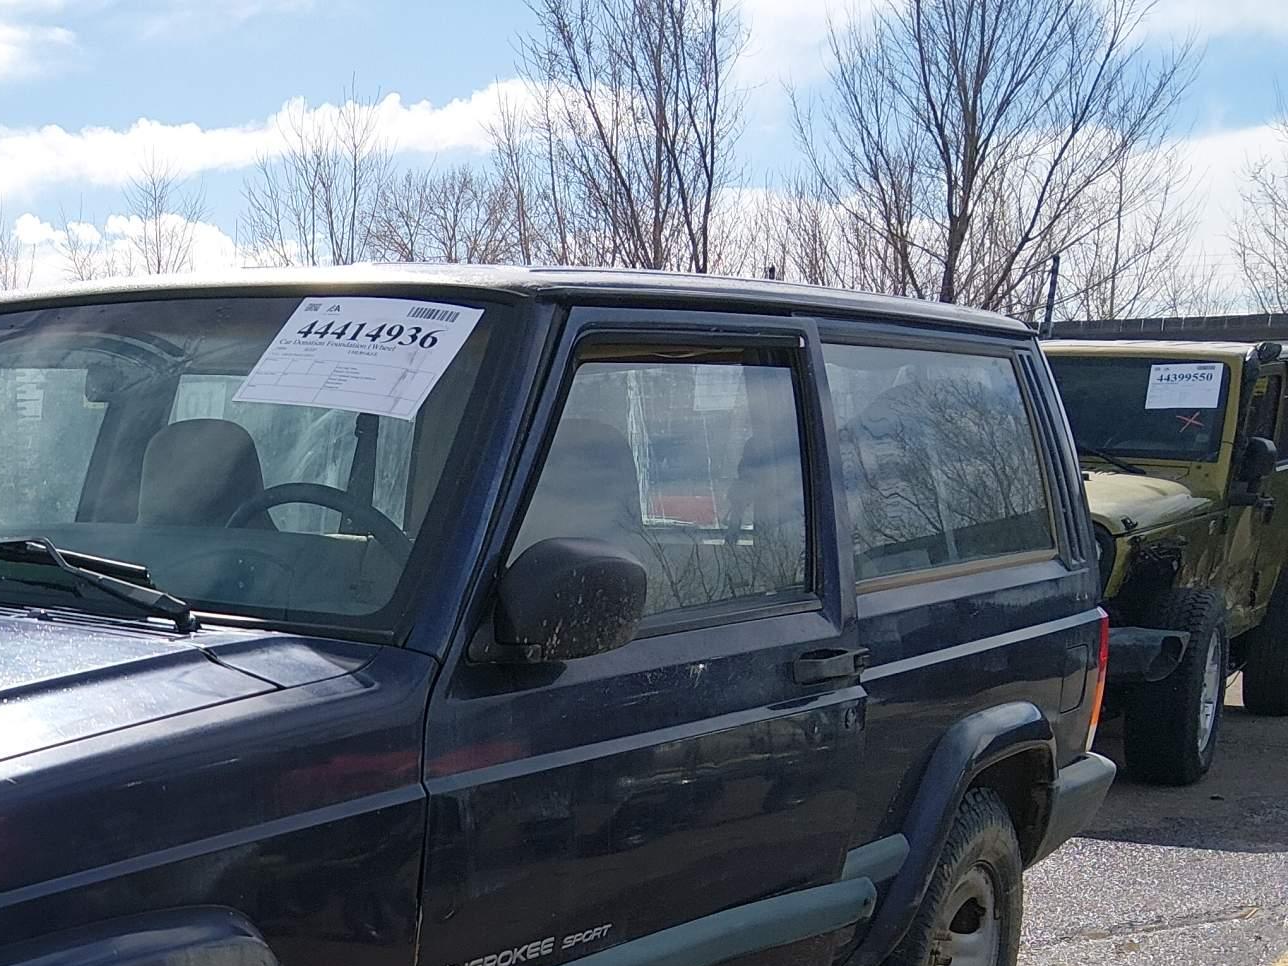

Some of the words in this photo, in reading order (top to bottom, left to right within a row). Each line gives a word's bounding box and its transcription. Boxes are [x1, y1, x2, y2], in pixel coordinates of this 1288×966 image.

[297, 320, 446, 348] 44414936
[1156, 373, 1213, 382] 44399550
[561, 924, 612, 949] SPORT
